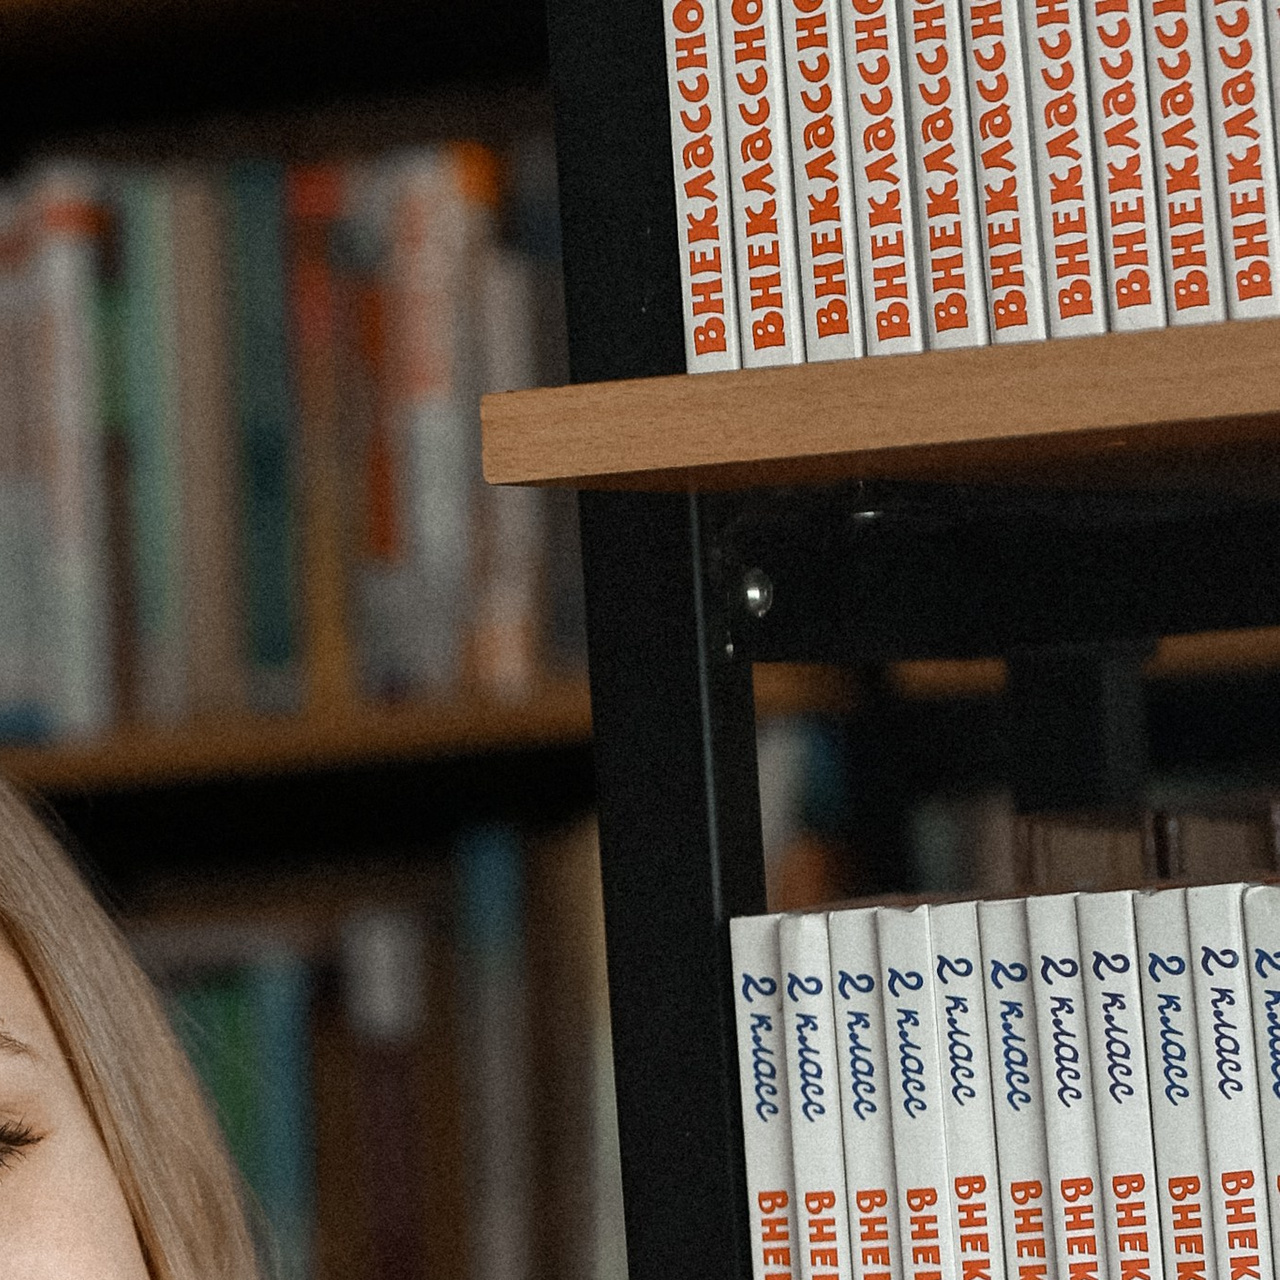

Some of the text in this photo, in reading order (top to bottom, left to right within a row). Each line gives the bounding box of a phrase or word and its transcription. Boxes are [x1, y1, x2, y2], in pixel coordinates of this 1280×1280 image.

[741, 973, 780, 1125] 2 класс
[787, 972, 827, 1124] 2 класс
[838, 970, 878, 1123] 2 класс
[887, 967, 928, 1121] 2 класс
[936, 954, 977, 1108] 2 класс
[990, 959, 1033, 1113] 2 класс
[1040, 955, 1083, 1110] 2 класс
[1092, 950, 1135, 1106] 2 класс
[1148, 952, 1191, 1108] 2 класс
[1201, 946, 1244, 1102] 2 класс
